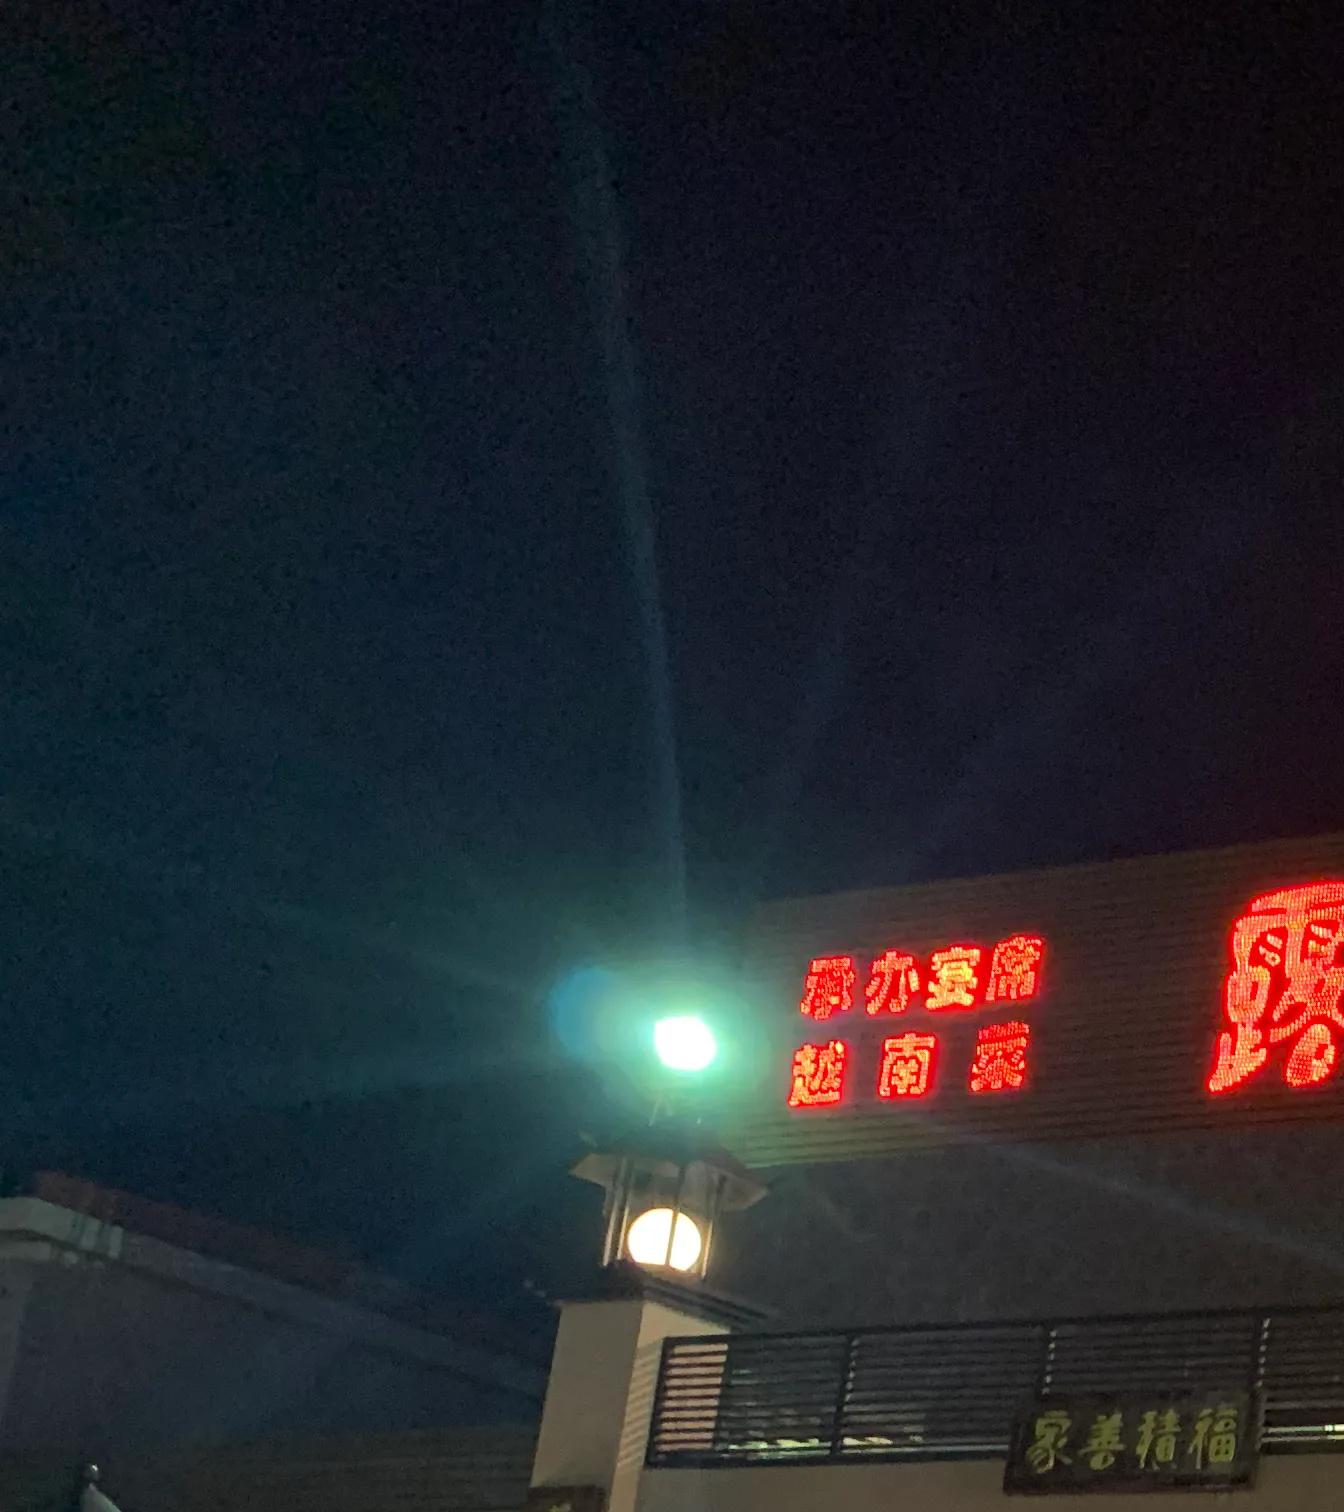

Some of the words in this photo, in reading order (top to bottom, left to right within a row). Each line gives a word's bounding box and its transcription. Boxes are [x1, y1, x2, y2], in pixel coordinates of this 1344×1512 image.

[800, 936, 1043, 1020] 承办宴席
[788, 1022, 1030, 1107] 越南菜
